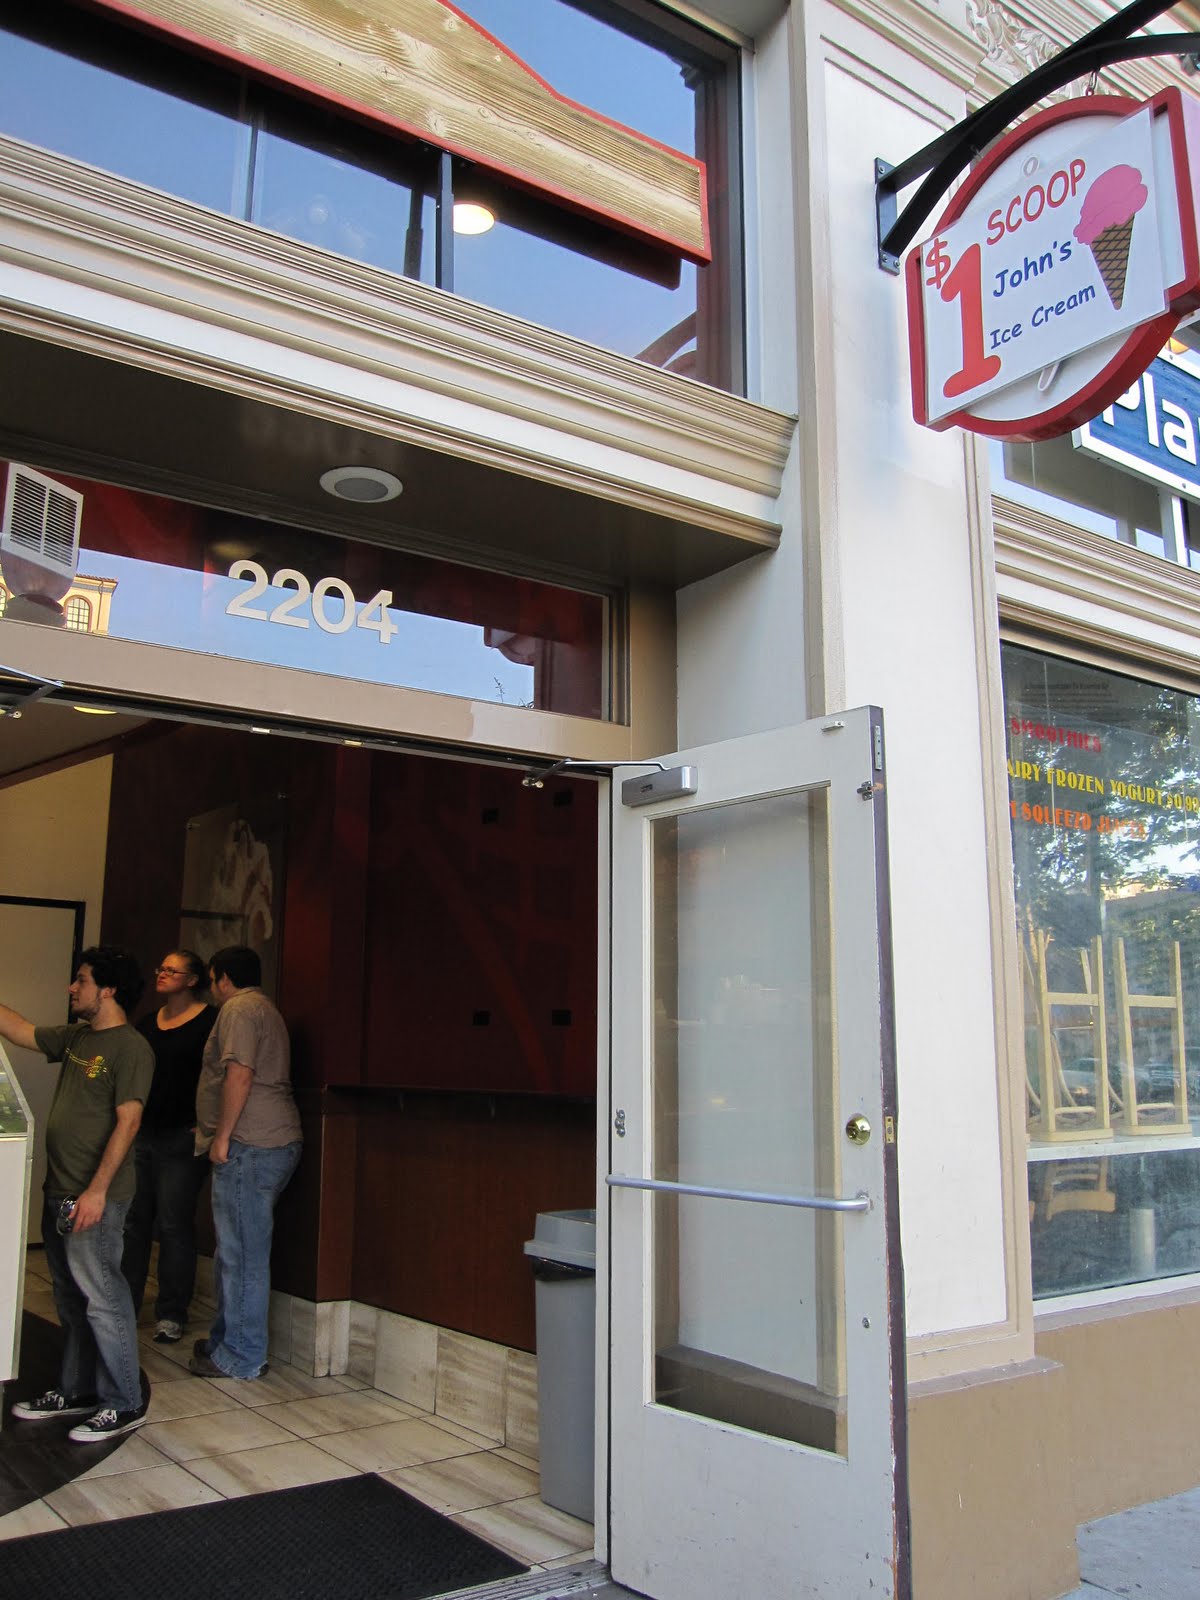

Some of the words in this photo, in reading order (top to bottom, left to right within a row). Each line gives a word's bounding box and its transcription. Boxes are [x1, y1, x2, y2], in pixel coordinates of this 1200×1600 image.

[986, 158, 1085, 245] SCOOP
[993, 241, 1072, 297] John's
[990, 323, 1022, 349] Ice
[1031, 285, 1096, 327] Cream
[1103, 371, 1200, 466] Pla
[225, 559, 398, 644] 2204
[1010, 715, 1102, 753] SMOOTHIES
[1047, 767, 1104, 795] FROZEN
[1110, 779, 1162, 806] YOGURT
